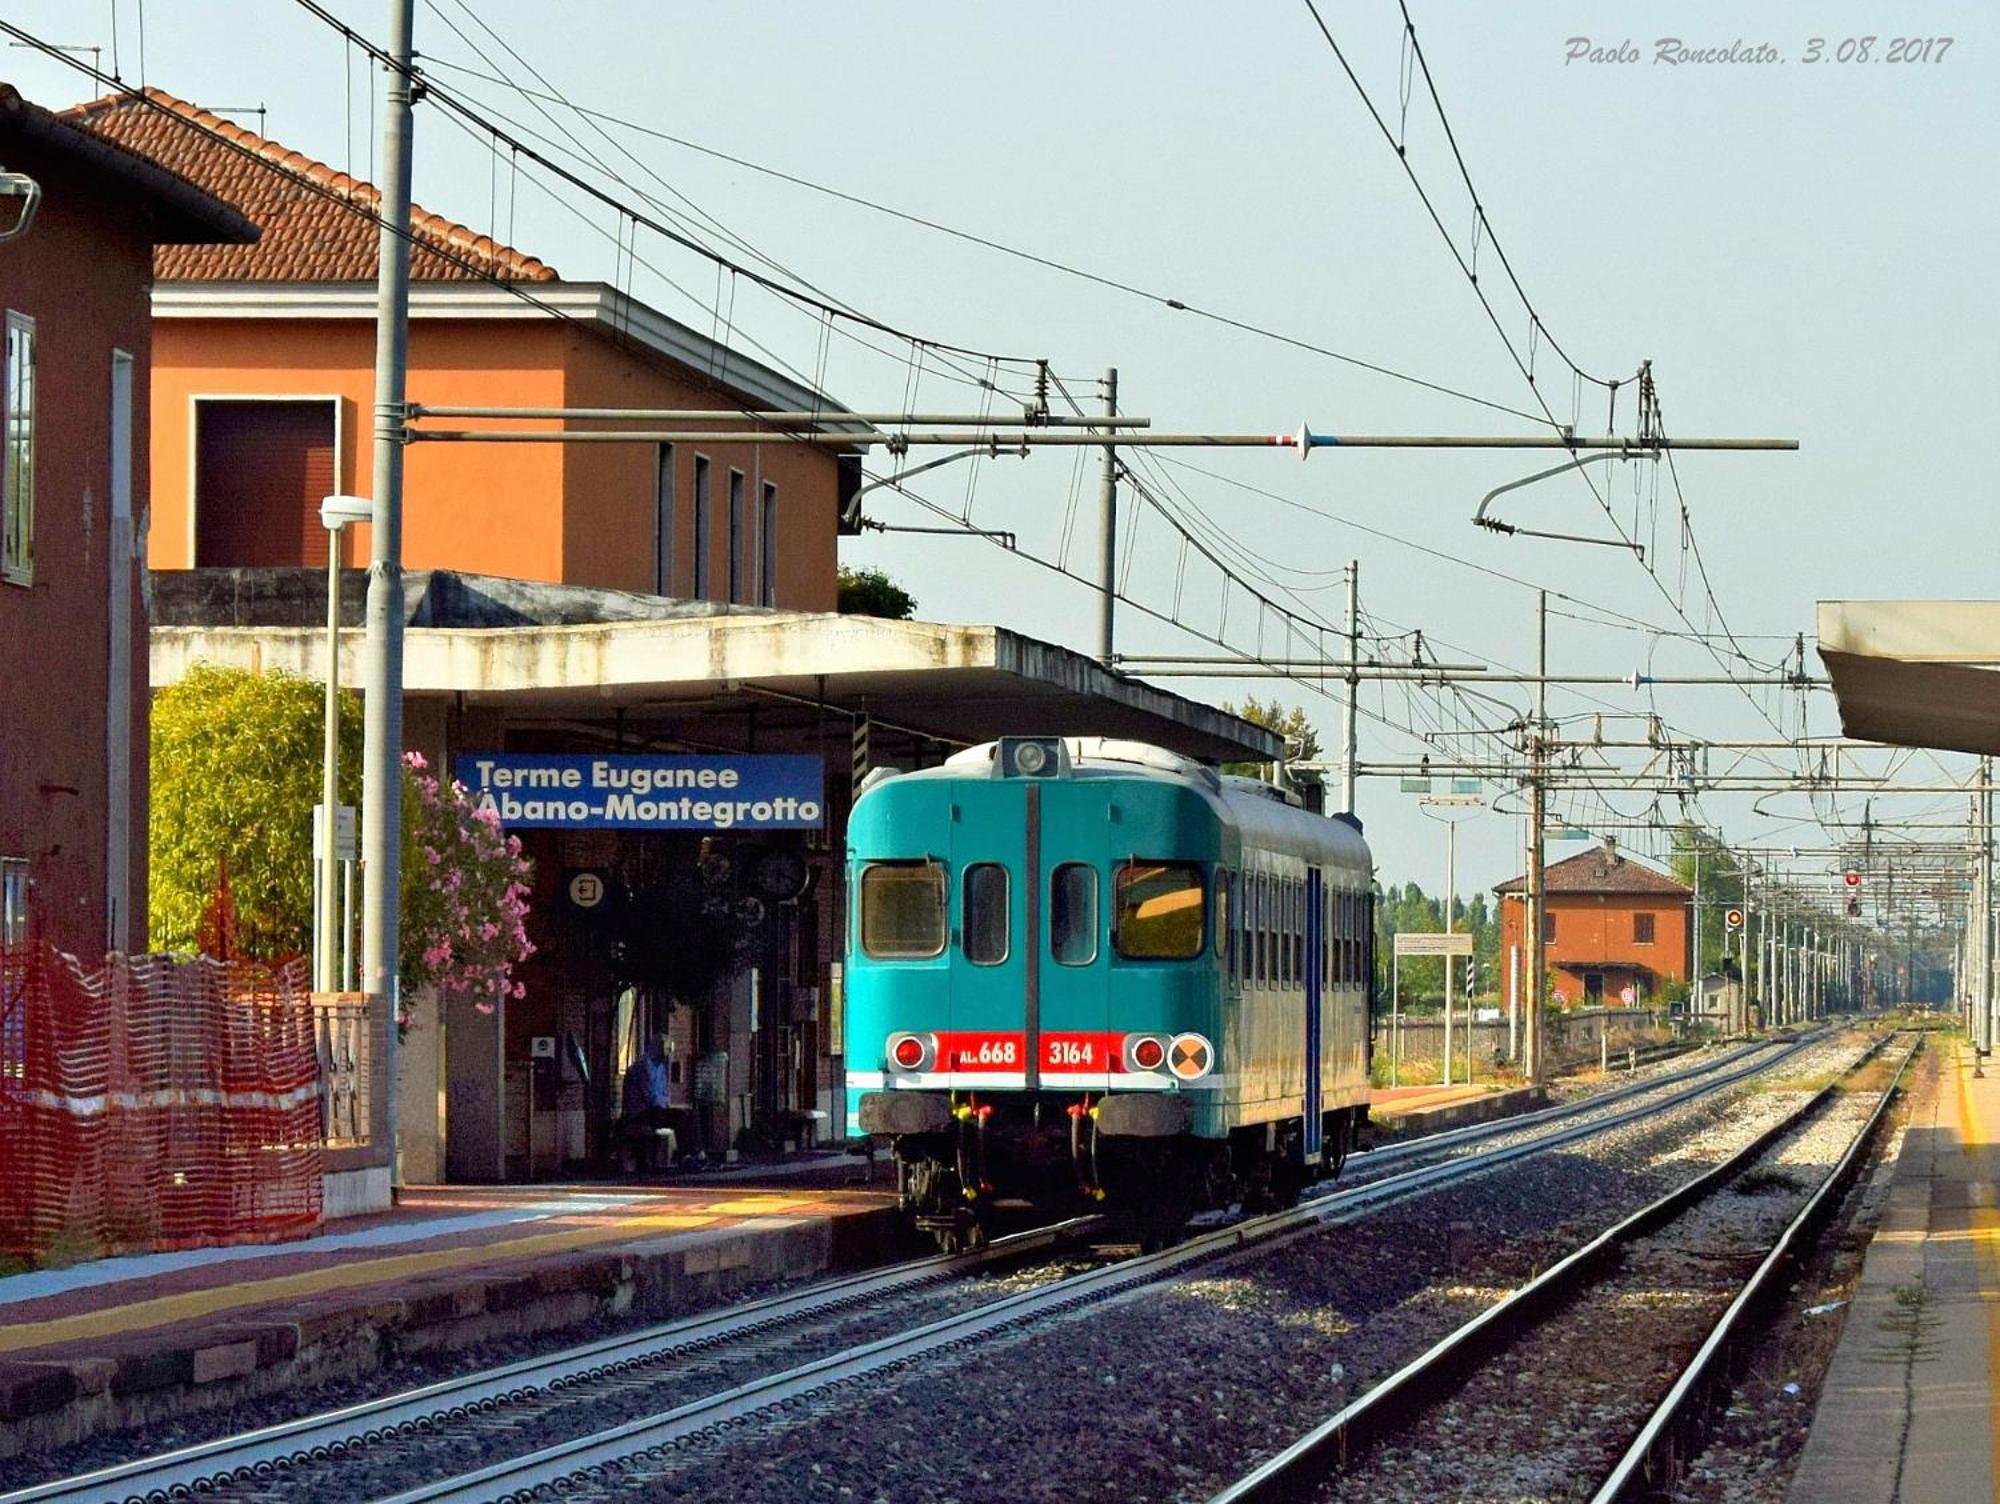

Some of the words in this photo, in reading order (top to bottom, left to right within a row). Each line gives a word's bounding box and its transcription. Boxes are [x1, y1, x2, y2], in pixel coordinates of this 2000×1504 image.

[475, 760, 582, 788] Terme
[592, 761, 739, 794] Euganee
[476, 794, 820, 827] Abano-Montegrotto
[1049, 1041, 1093, 1064] 3164
